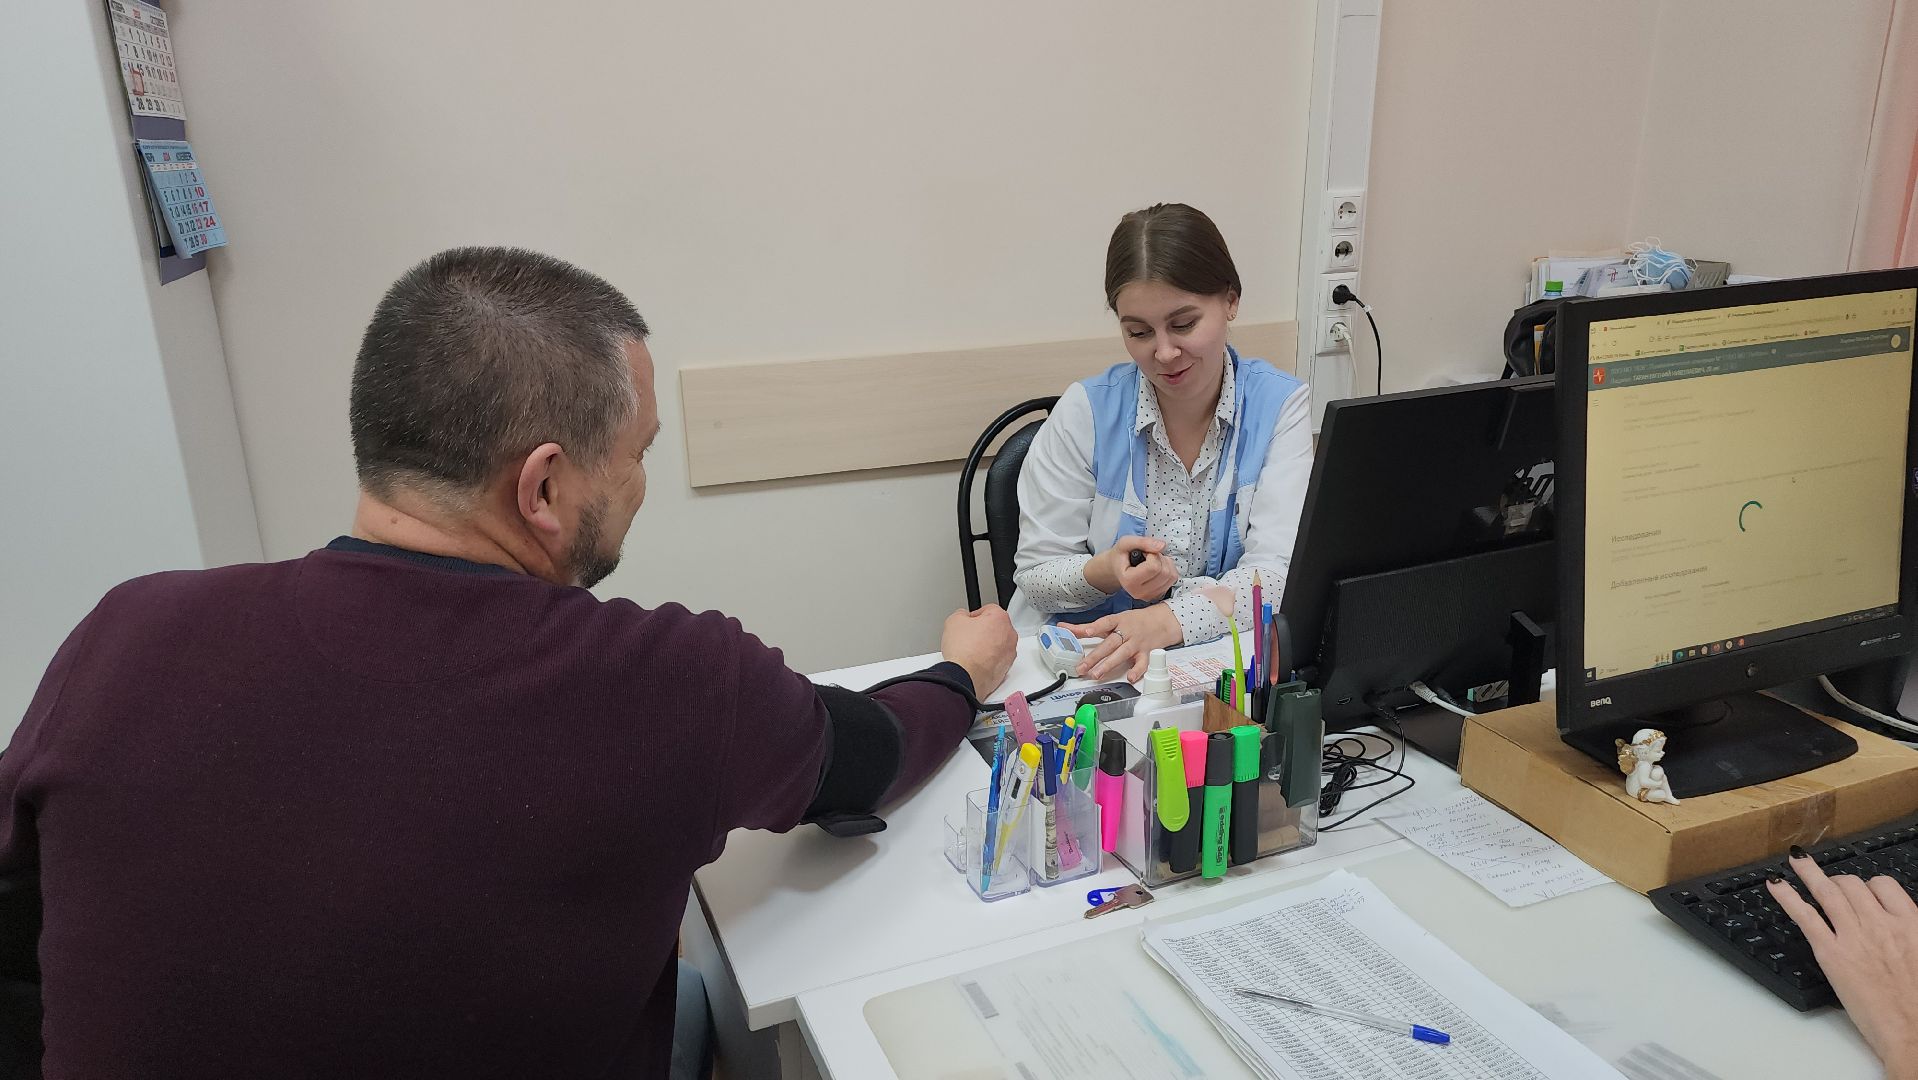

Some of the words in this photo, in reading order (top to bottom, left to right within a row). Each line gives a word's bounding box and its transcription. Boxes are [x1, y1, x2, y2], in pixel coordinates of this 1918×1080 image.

[195, 187, 204, 198] 10
[199, 201, 208, 212] 17
[204, 216, 216, 228] 24
[1590, 696, 1612, 708] BenQ
